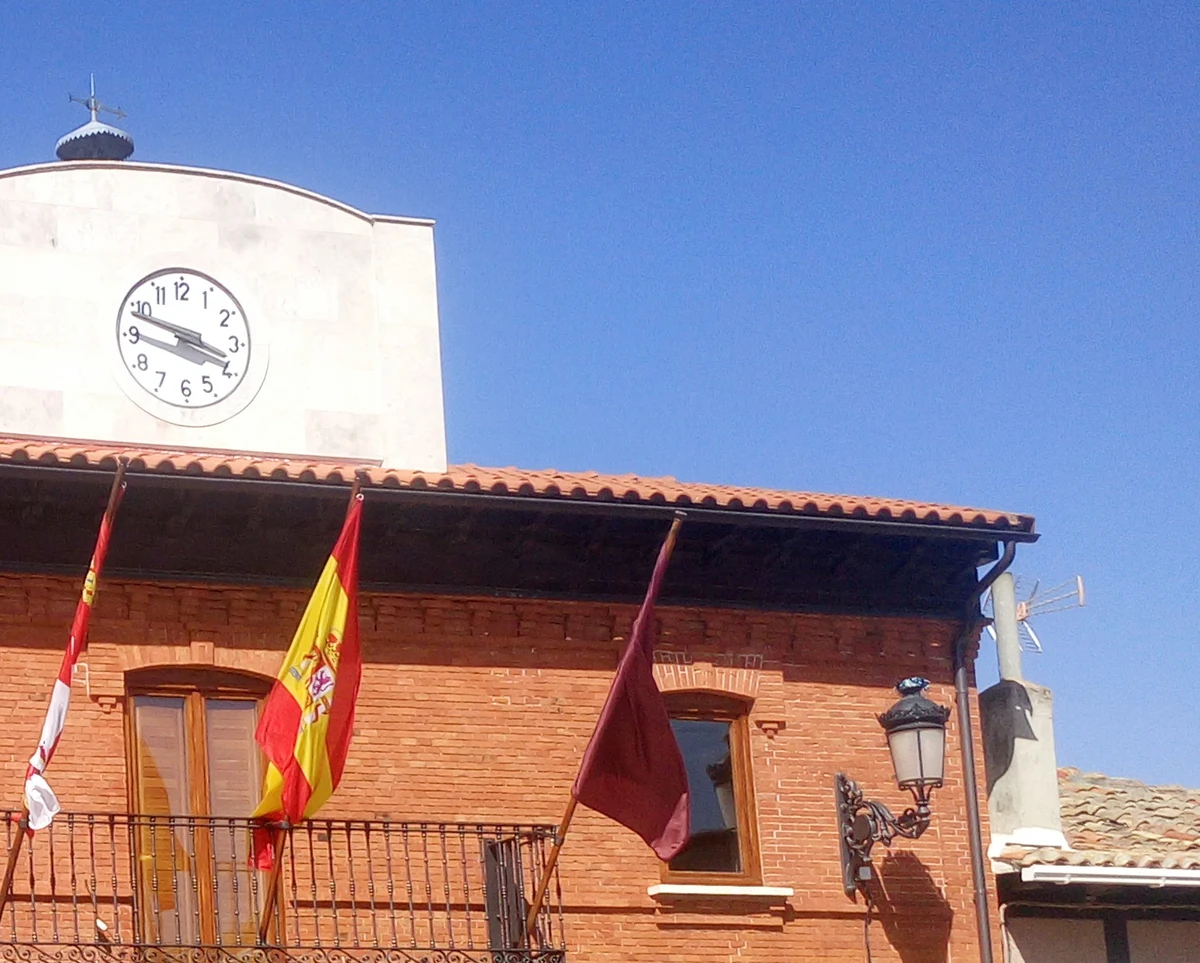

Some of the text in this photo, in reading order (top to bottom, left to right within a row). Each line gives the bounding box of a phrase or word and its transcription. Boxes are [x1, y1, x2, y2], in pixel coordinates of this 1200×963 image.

[155, 286, 166, 305] 11
[174, 281, 190, 301] 12
[202, 291, 207, 309] 1
[136, 300, 152, 317] 10
[219, 309, 230, 327] 2
[128, 326, 140, 344] 9
[228, 335, 239, 353] 3
[137, 353, 148, 371] 8
[222, 360, 233, 379] 4
[155, 371, 166, 388] 7
[181, 379, 192, 397] 6
[202, 375, 213, 393] 5
